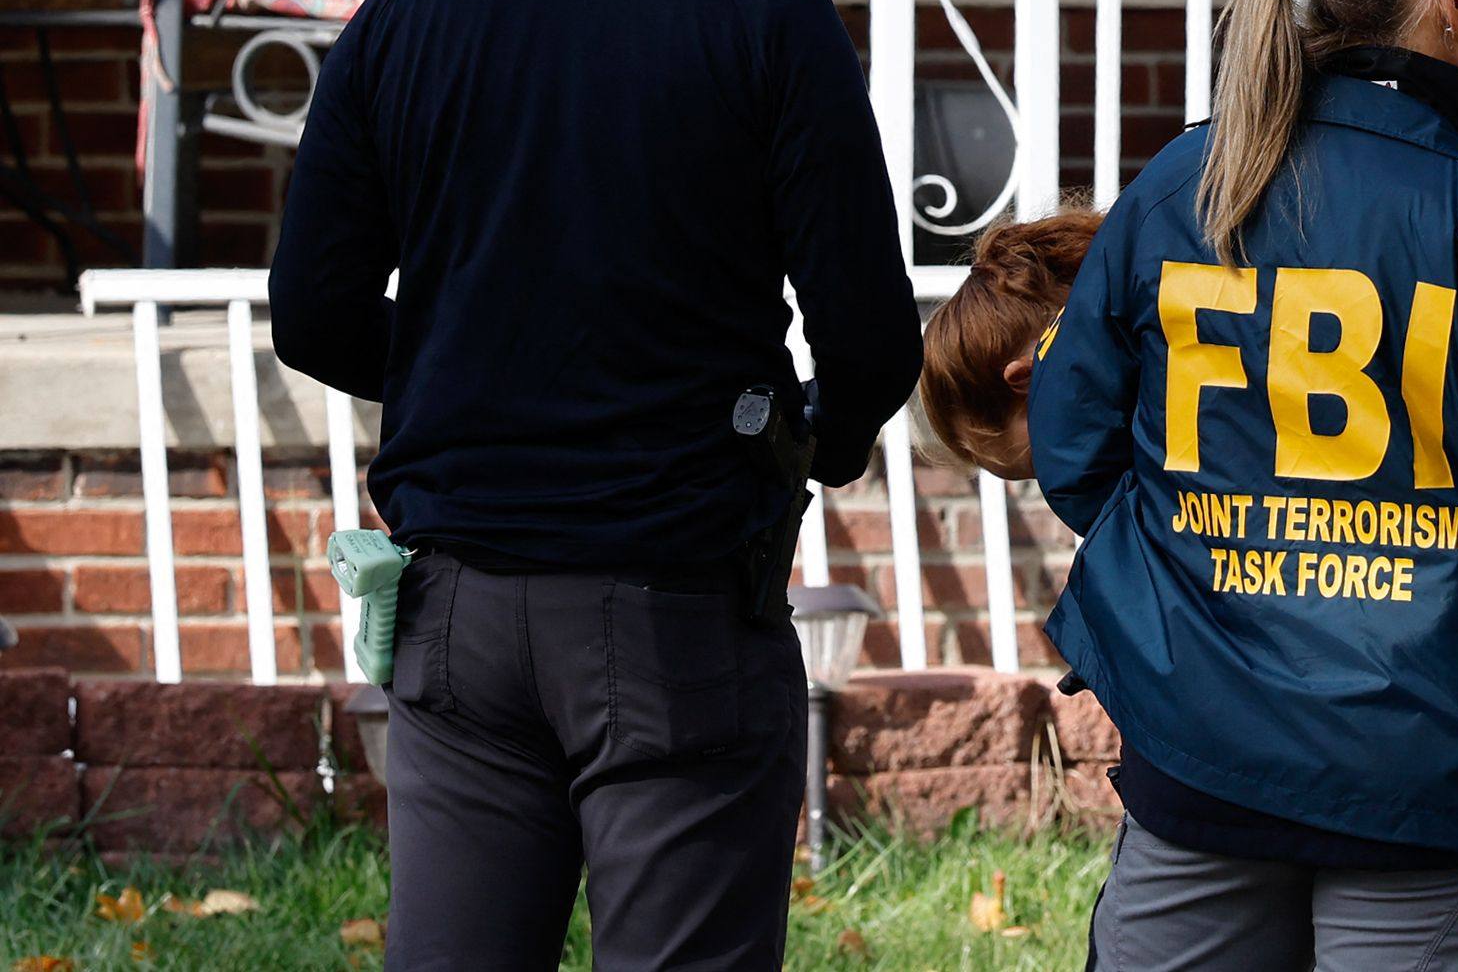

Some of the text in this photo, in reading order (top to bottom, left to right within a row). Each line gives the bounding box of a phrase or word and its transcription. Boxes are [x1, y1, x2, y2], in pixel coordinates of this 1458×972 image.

[1158, 260, 1457, 489] FBI
[1172, 491, 1254, 538] JOINT
[1210, 548, 1415, 601] TASK FORCE
